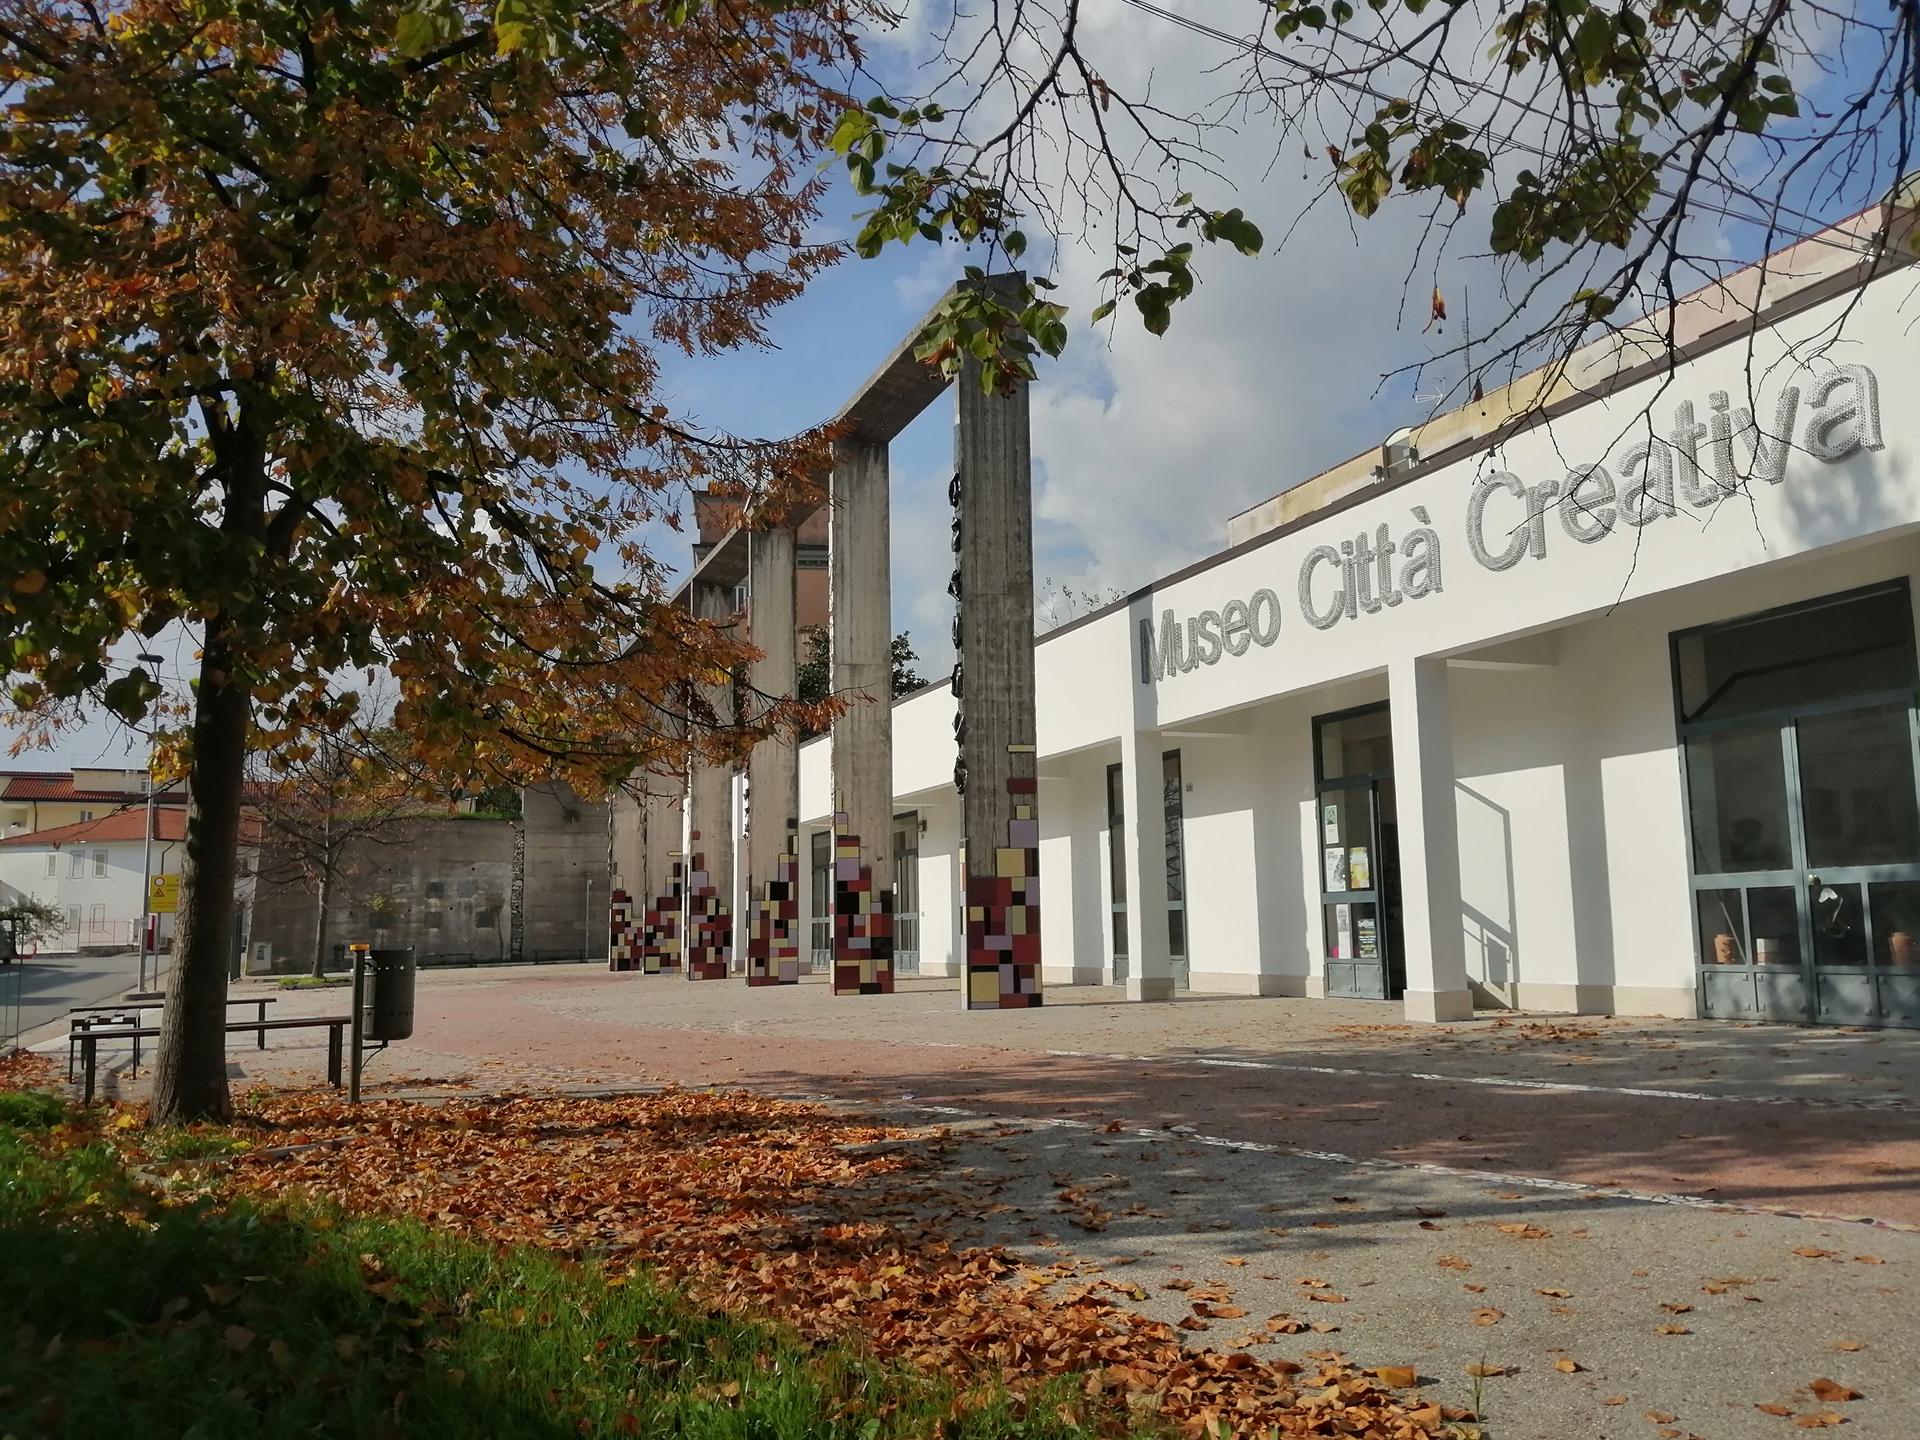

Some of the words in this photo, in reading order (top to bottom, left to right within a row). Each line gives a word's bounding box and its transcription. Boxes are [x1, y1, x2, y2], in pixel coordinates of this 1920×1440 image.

[1139, 588, 1282, 684] Museo
[1298, 505, 1444, 630] Città
[1466, 363, 1885, 572] Creativa
